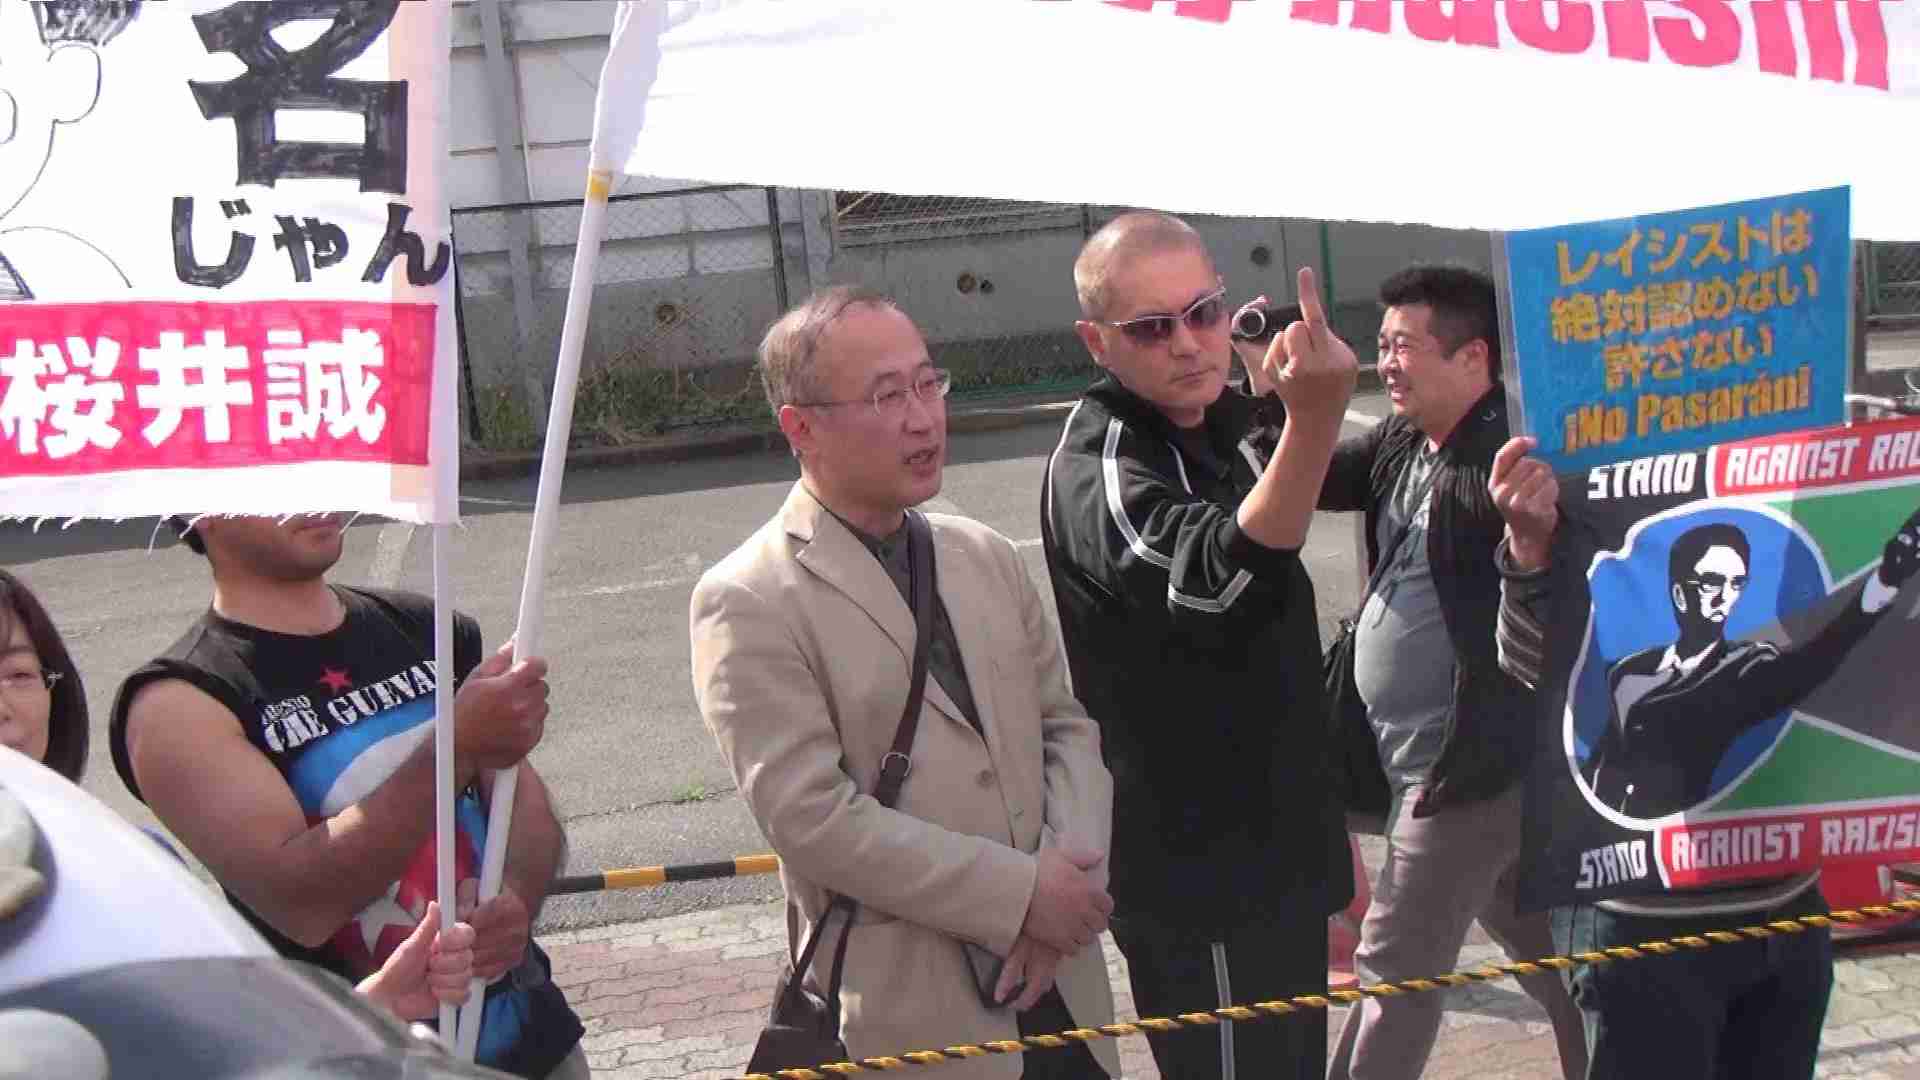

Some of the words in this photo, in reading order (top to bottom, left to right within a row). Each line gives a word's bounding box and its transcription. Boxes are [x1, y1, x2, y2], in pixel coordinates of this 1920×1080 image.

[188, 0, 409, 194] 名
[172, 196, 450, 289] じゃん
[1555, 209, 1814, 286] レイシストは
[1550, 265, 1820, 343] 絶対認めない
[0, 329, 388, 459] 桜井誠
[1604, 326, 1774, 392] 許さない
[1587, 452, 1698, 501] STAND
[1725, 437, 1861, 488] AGAINST
[328, 660, 455, 726] GUEVA
[1575, 840, 1646, 889] STAND
[1671, 821, 1805, 872] AGAINST
[1820, 812, 1920, 857] RACIS
